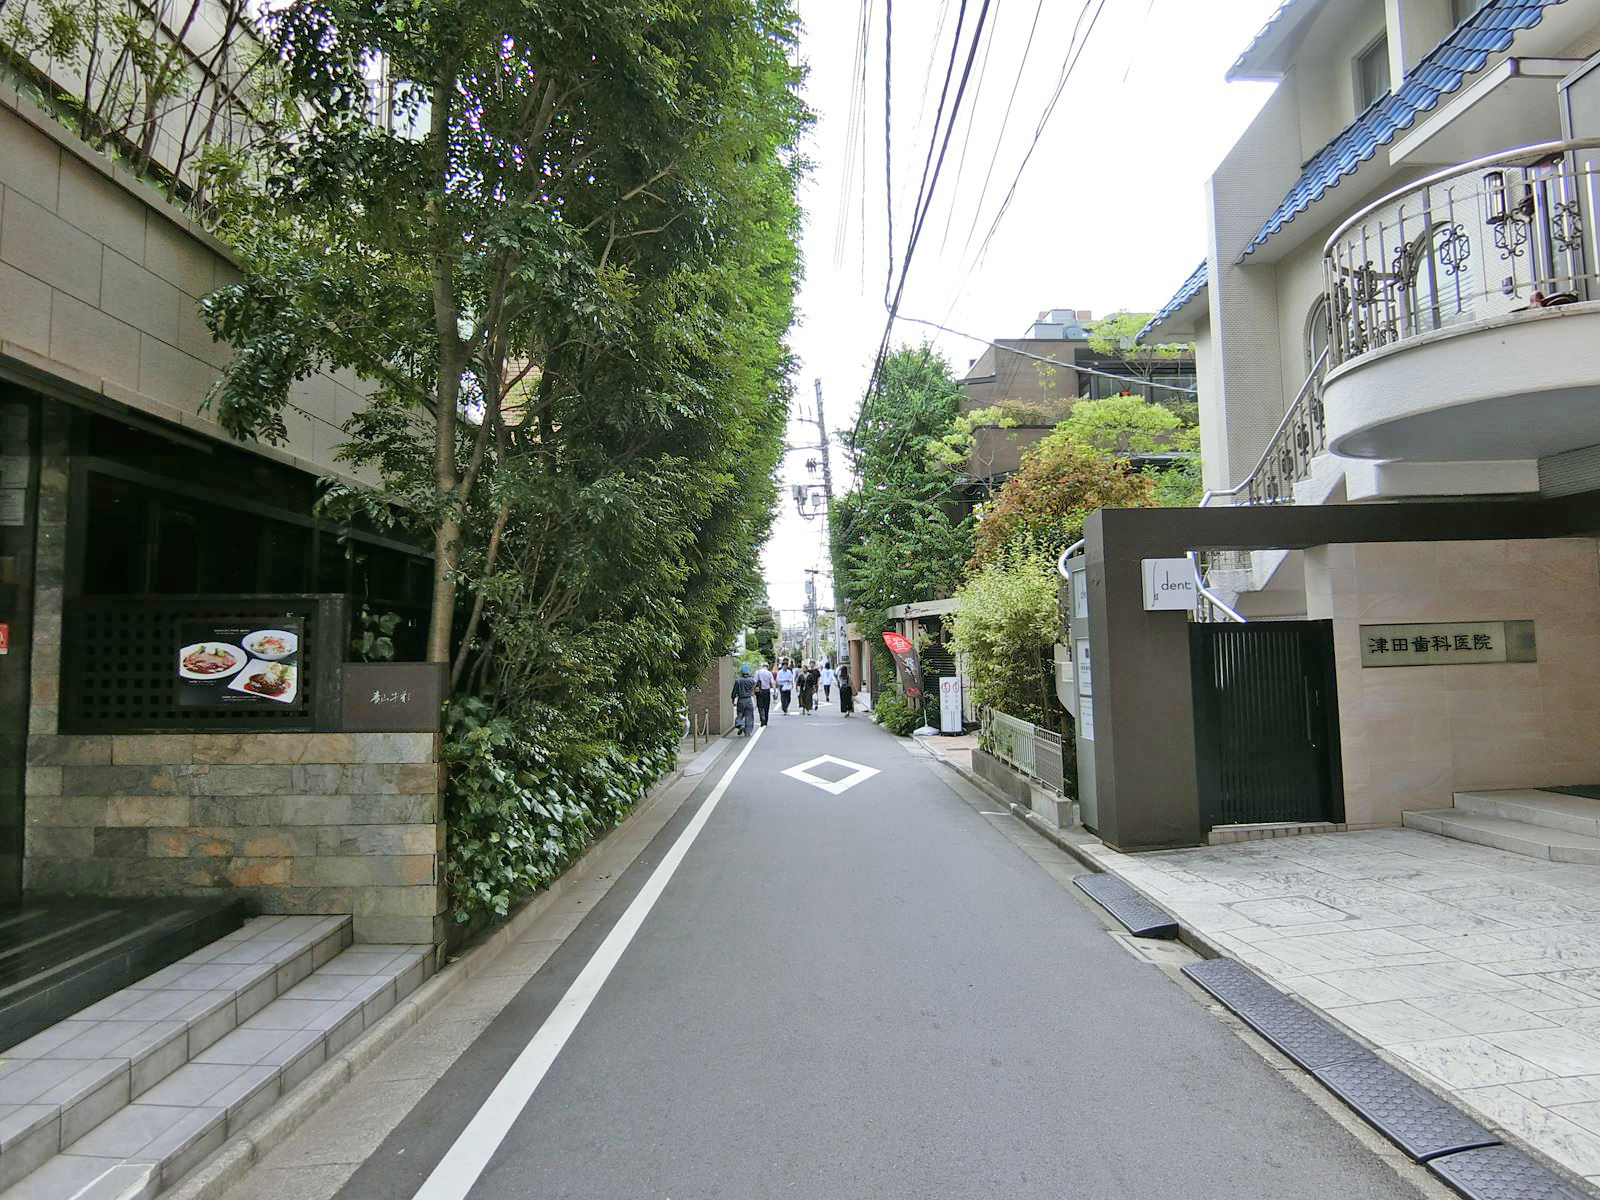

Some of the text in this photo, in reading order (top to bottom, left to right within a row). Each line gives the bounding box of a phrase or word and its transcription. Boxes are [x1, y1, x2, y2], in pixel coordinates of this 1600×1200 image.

[1161, 570, 1192, 590] dent
[1368, 634, 1493, 653] 津田歯科医院
